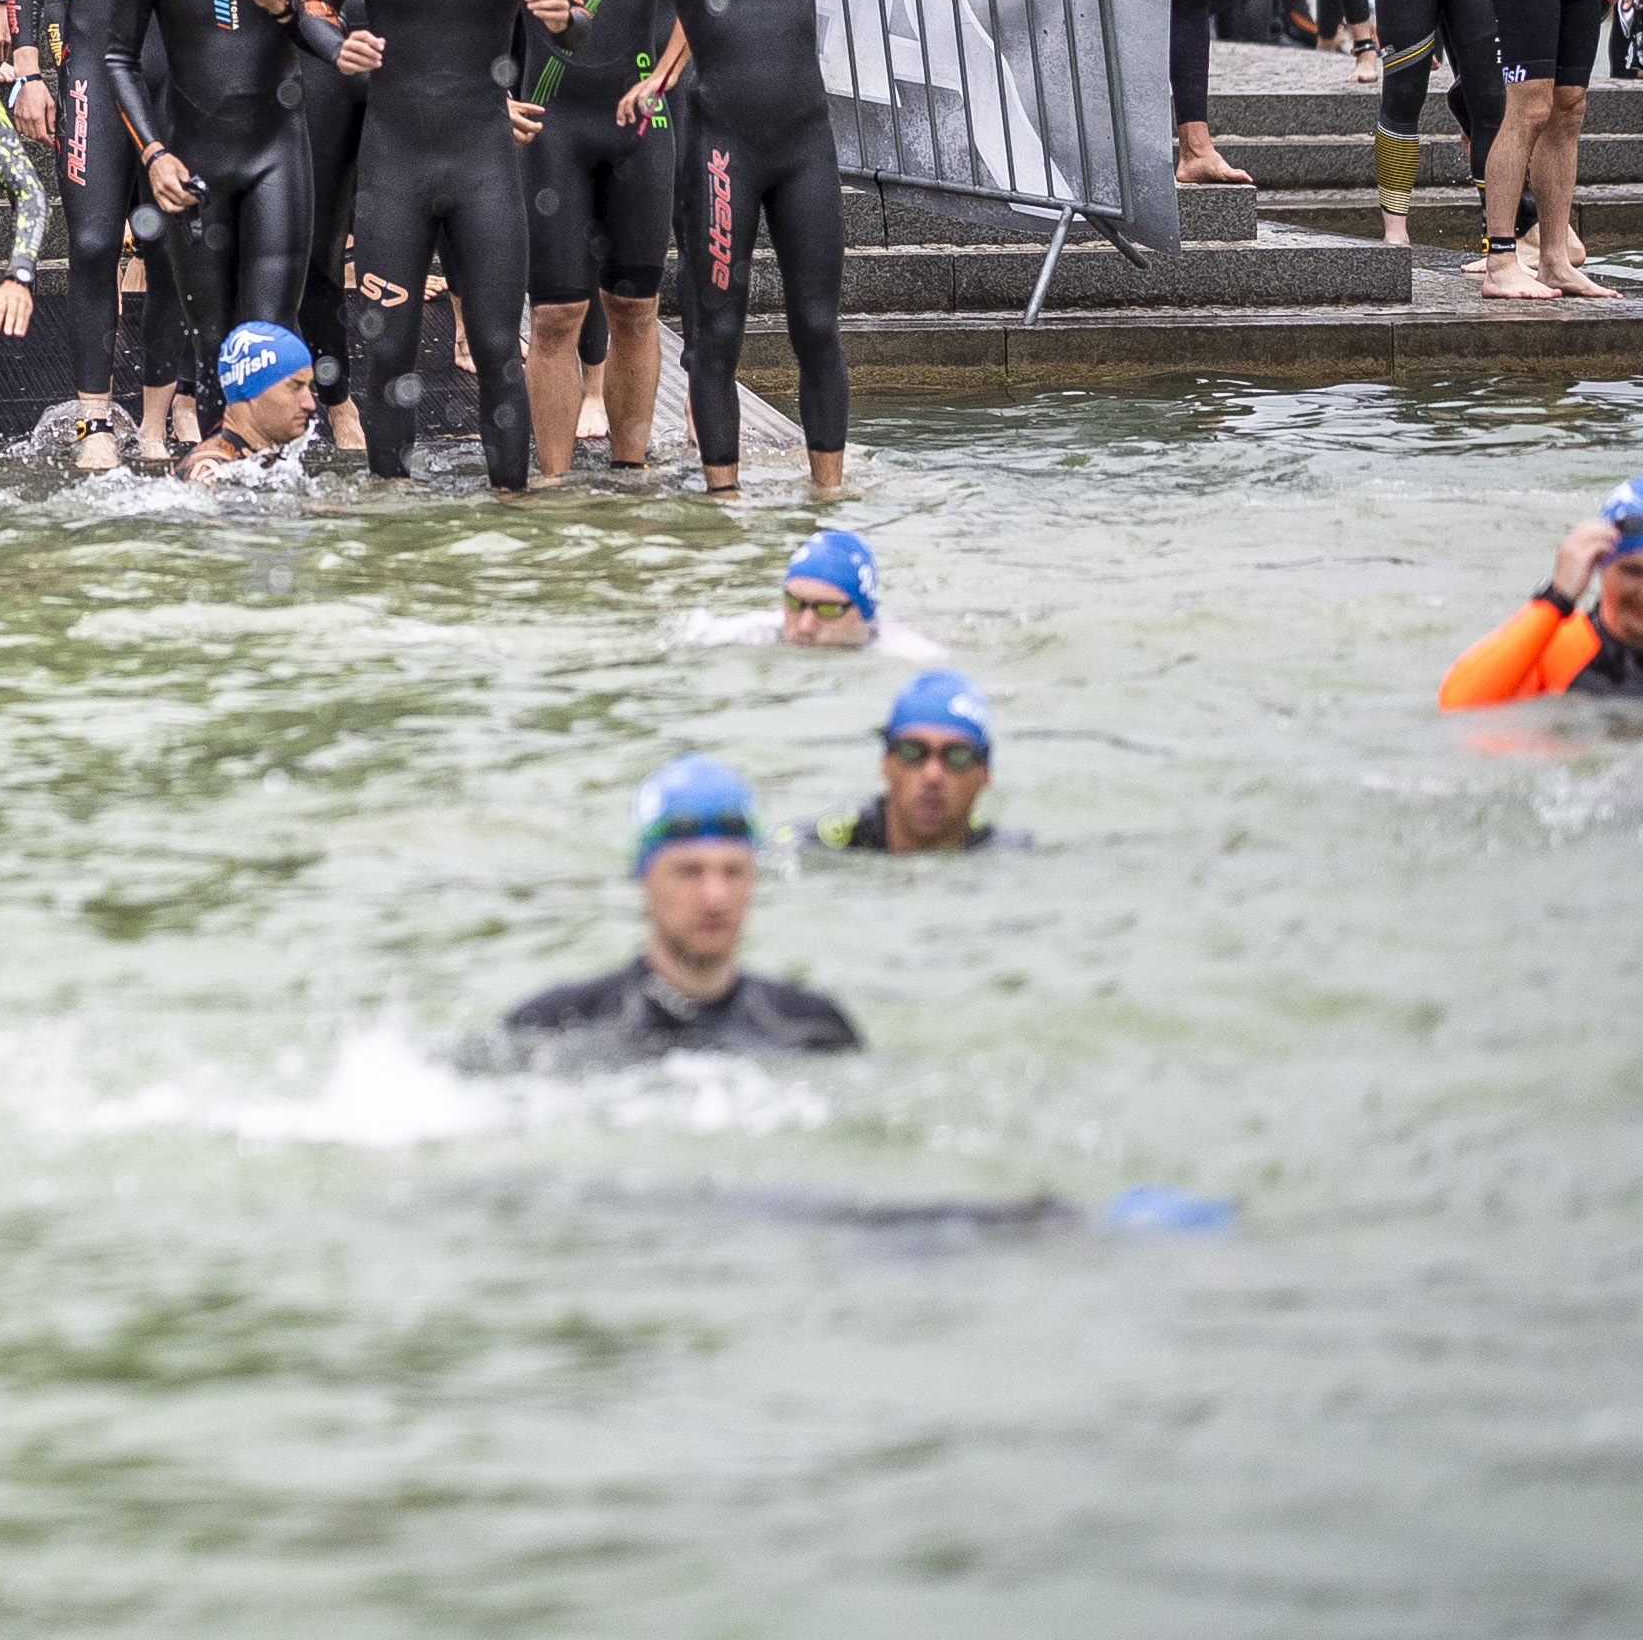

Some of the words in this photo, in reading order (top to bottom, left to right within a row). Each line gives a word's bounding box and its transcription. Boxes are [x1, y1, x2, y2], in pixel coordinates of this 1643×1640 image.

[636, 53, 668, 130] GDE
[1502, 66, 1526, 83] fish
[361, 273, 407, 308] S7
